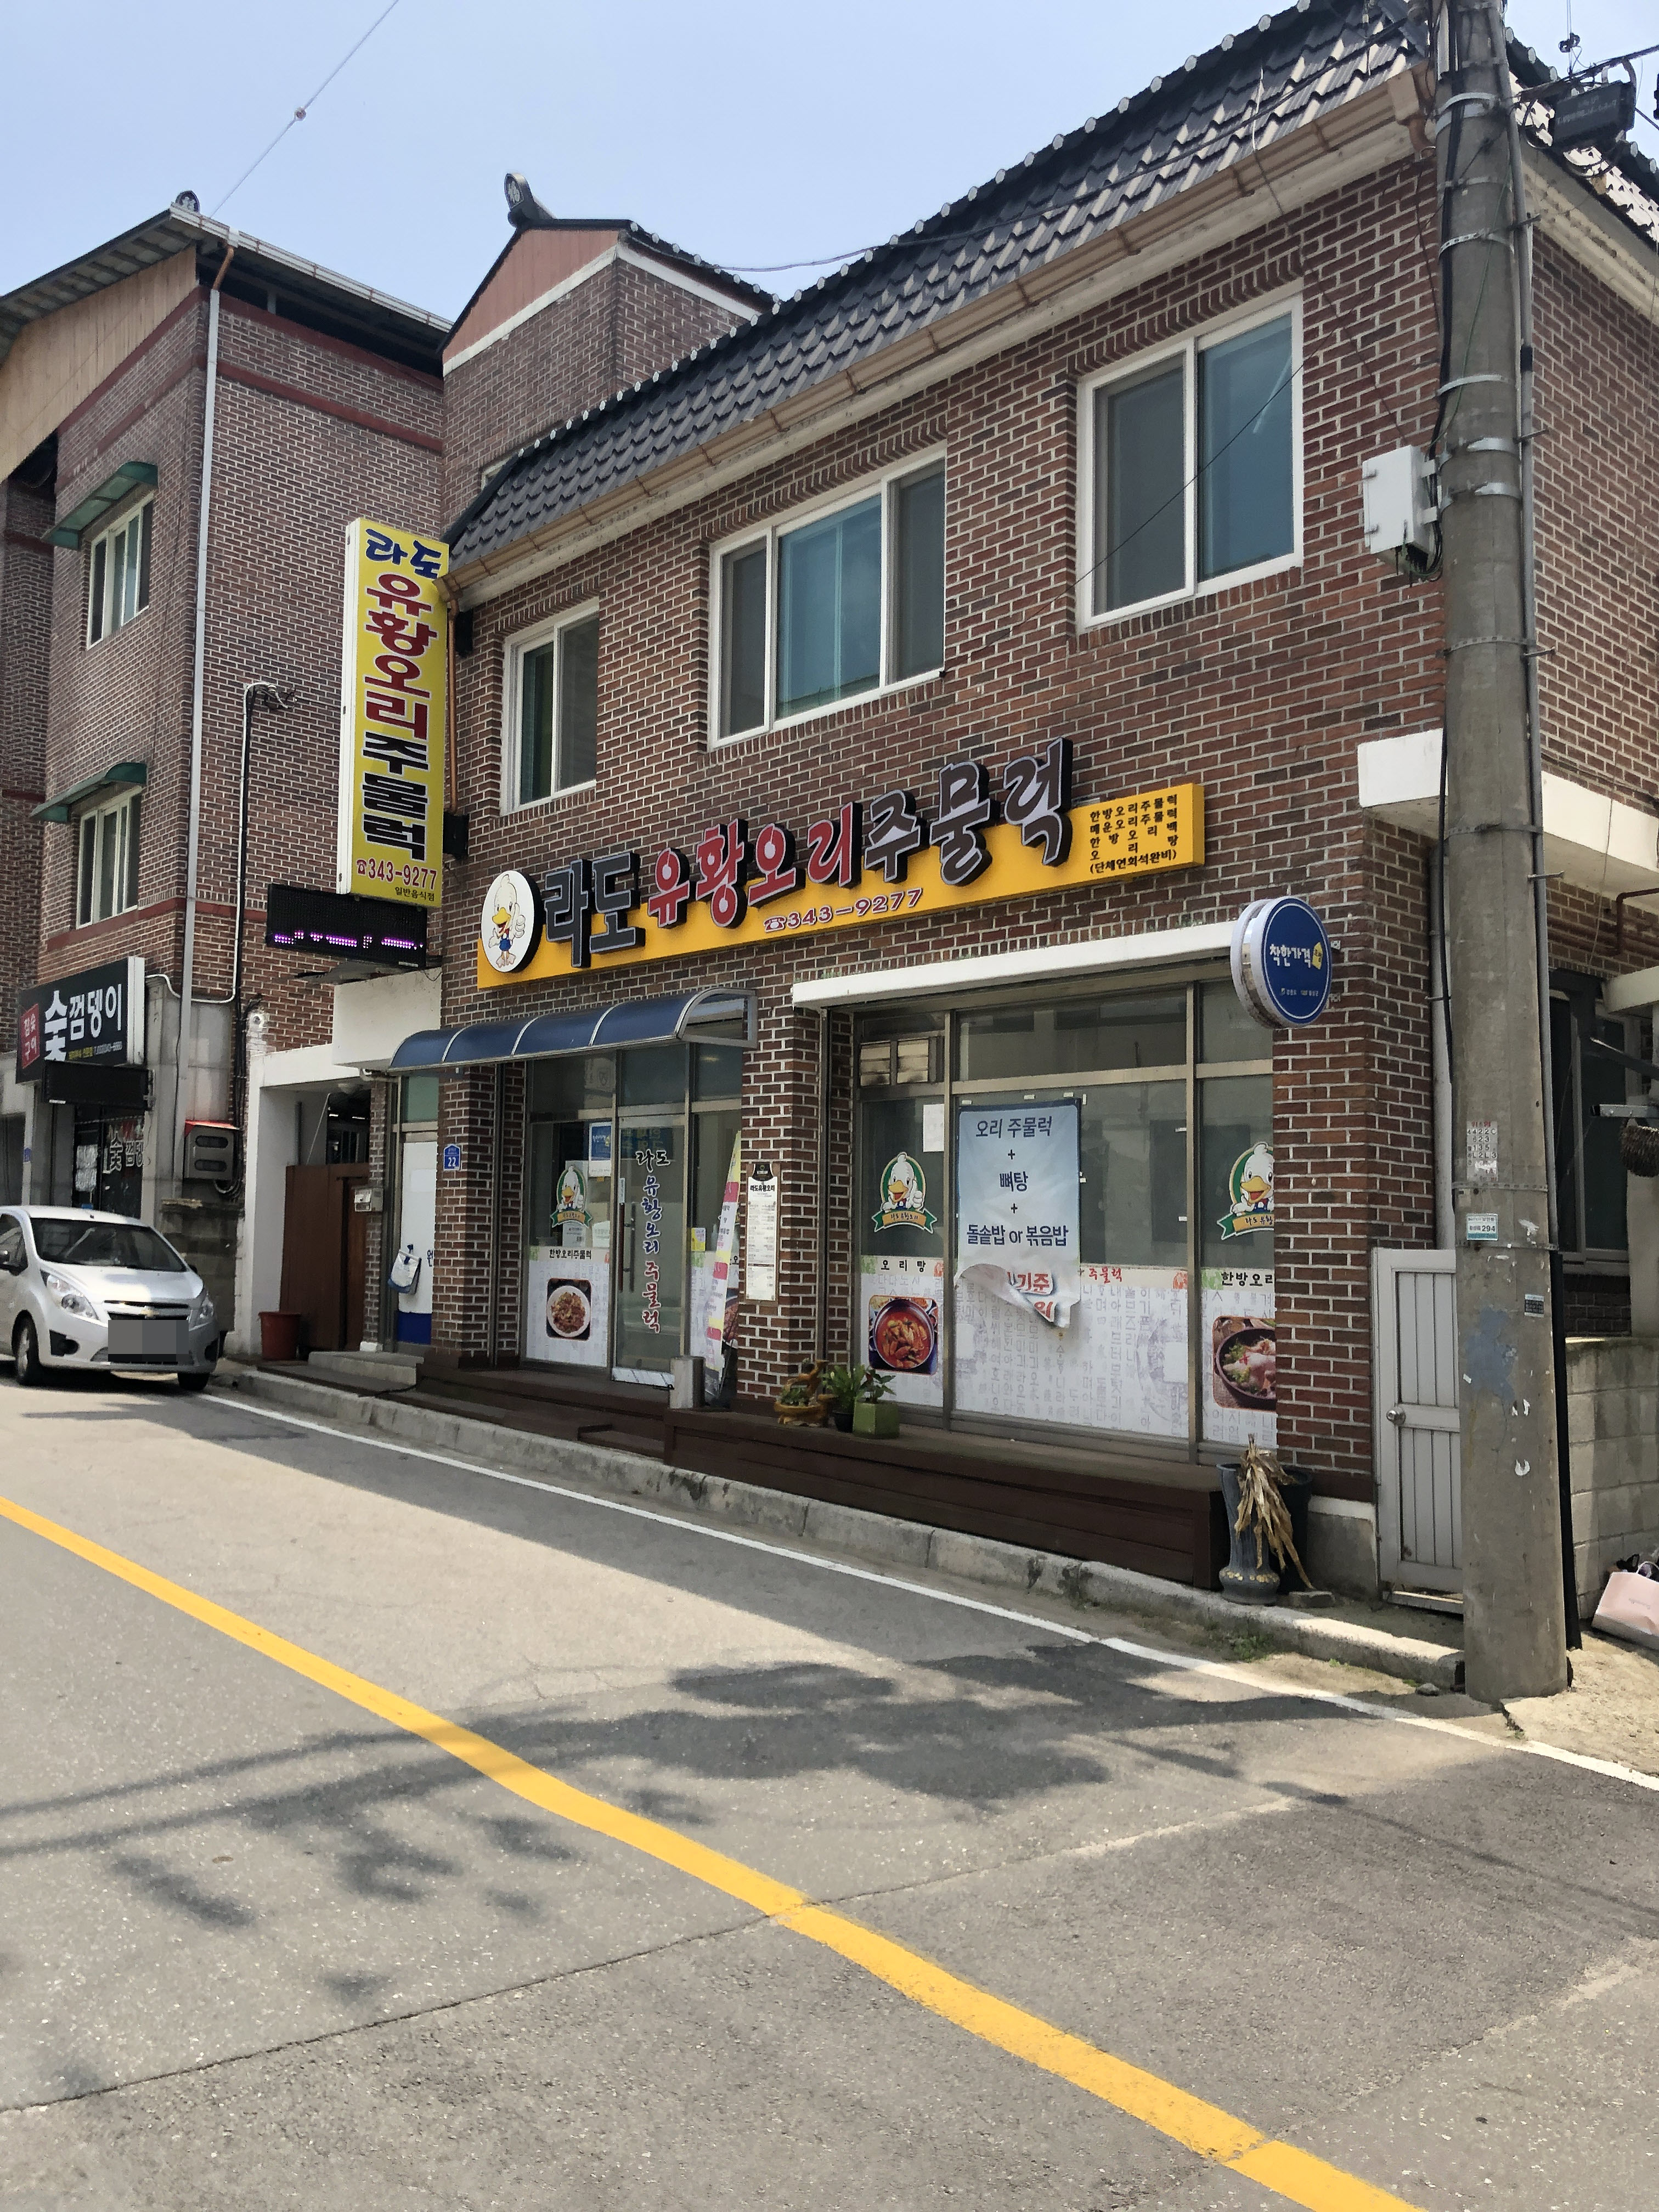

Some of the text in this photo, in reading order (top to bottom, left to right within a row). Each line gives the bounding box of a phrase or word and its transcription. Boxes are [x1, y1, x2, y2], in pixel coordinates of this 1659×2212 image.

[365, 528, 442, 580] 라도
[364, 573, 437, 741] 유황오리
[362, 730, 429, 862] 주물럭
[544, 736, 1069, 968] 라도 유황오리 주물럭
[368, 857, 437, 890] 343-9277
[395, 886, 435, 902] 일반음식점
[787, 887, 923, 928] 343-9277
[975, 1116, 1052, 1138] 오리 주물럭
[448, 1156, 456, 1167] 22
[635, 1149, 670, 1173] 라도
[1000, 1171, 1029, 1192] 뼈탕
[967, 1224, 1006, 1245] 돌솥밥
[1026, 1225, 1069, 1246] 볶음밥
[881, 1260, 926, 1273] 오리탕
[1089, 1266, 1122, 1284] 주물럭
[642, 1261, 662, 1334] 주물럭
